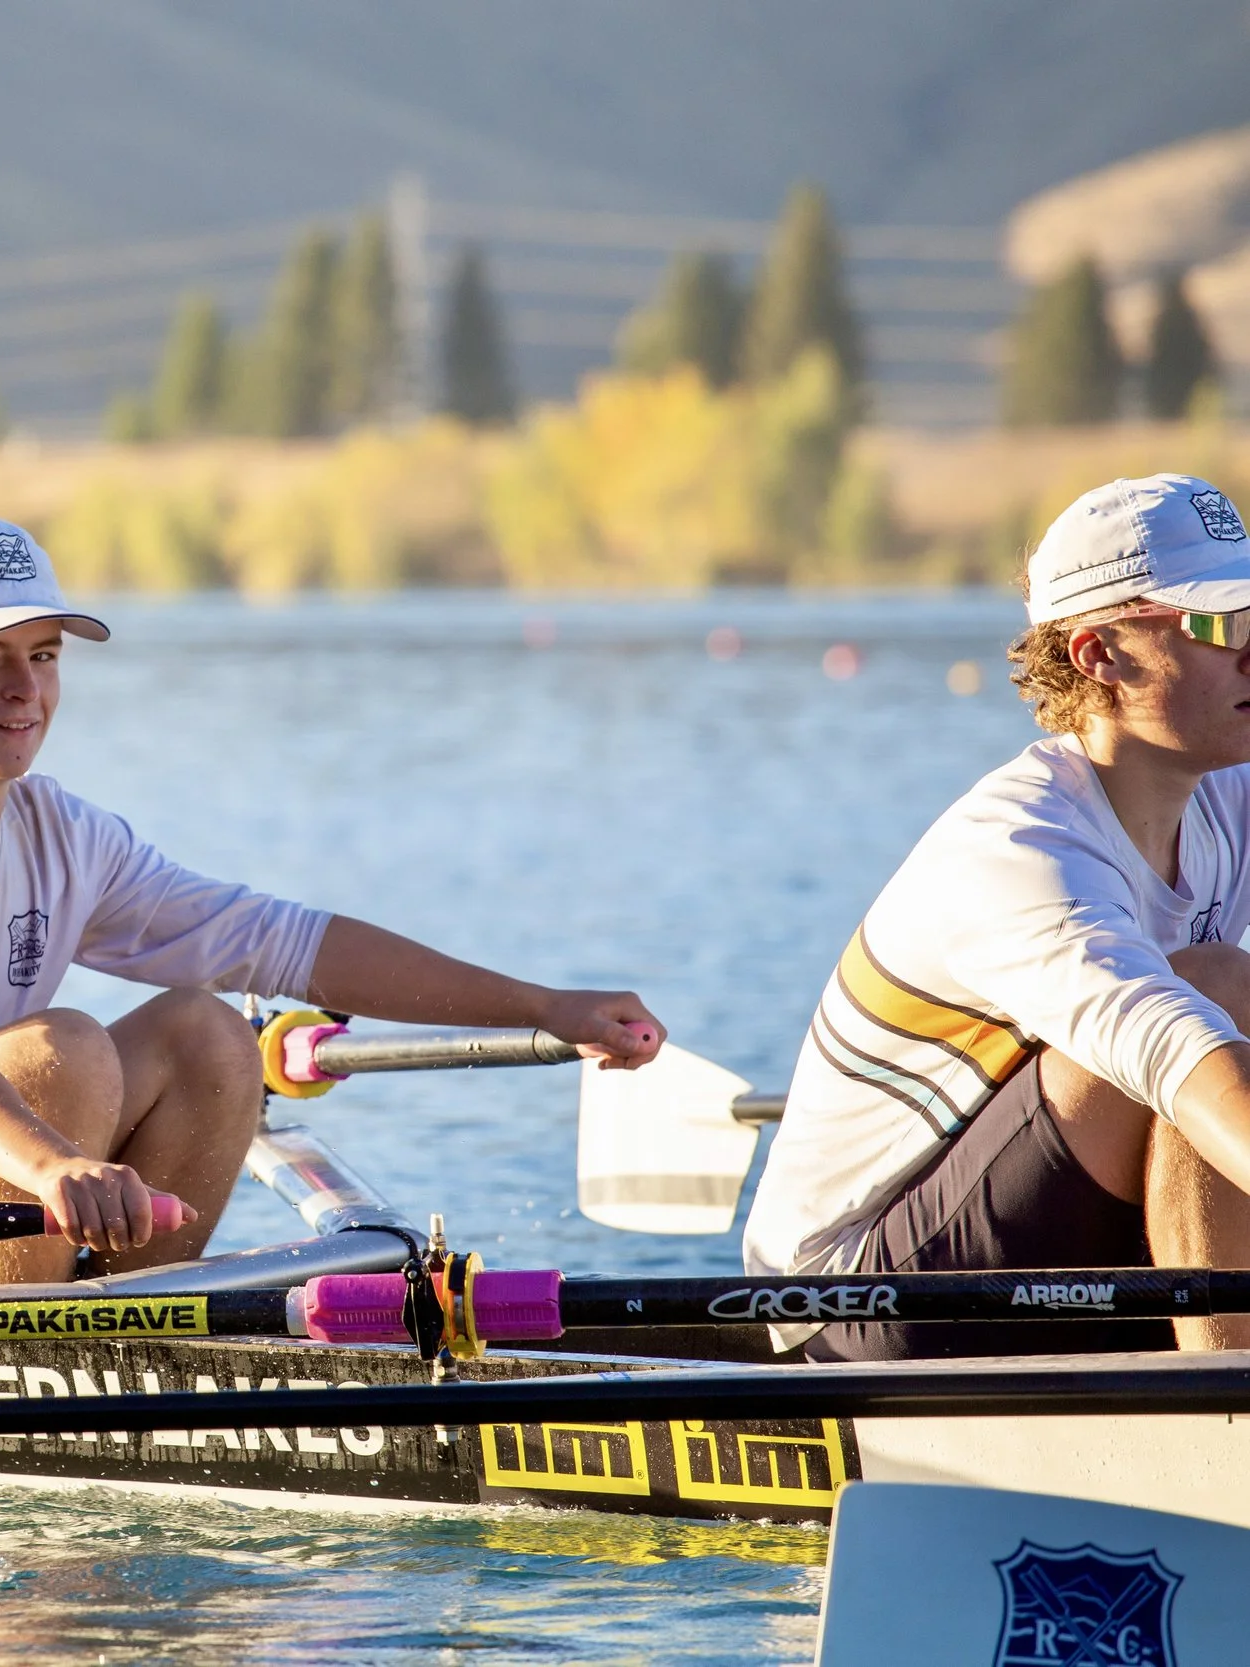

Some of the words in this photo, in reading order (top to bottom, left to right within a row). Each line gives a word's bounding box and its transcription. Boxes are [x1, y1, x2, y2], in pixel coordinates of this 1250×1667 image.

[707, 1285, 900, 1320] CROKER
[1010, 1283, 1116, 1306] ARROW
[1033, 1618, 1059, 1658] R
[1116, 1624, 1141, 1664] C
